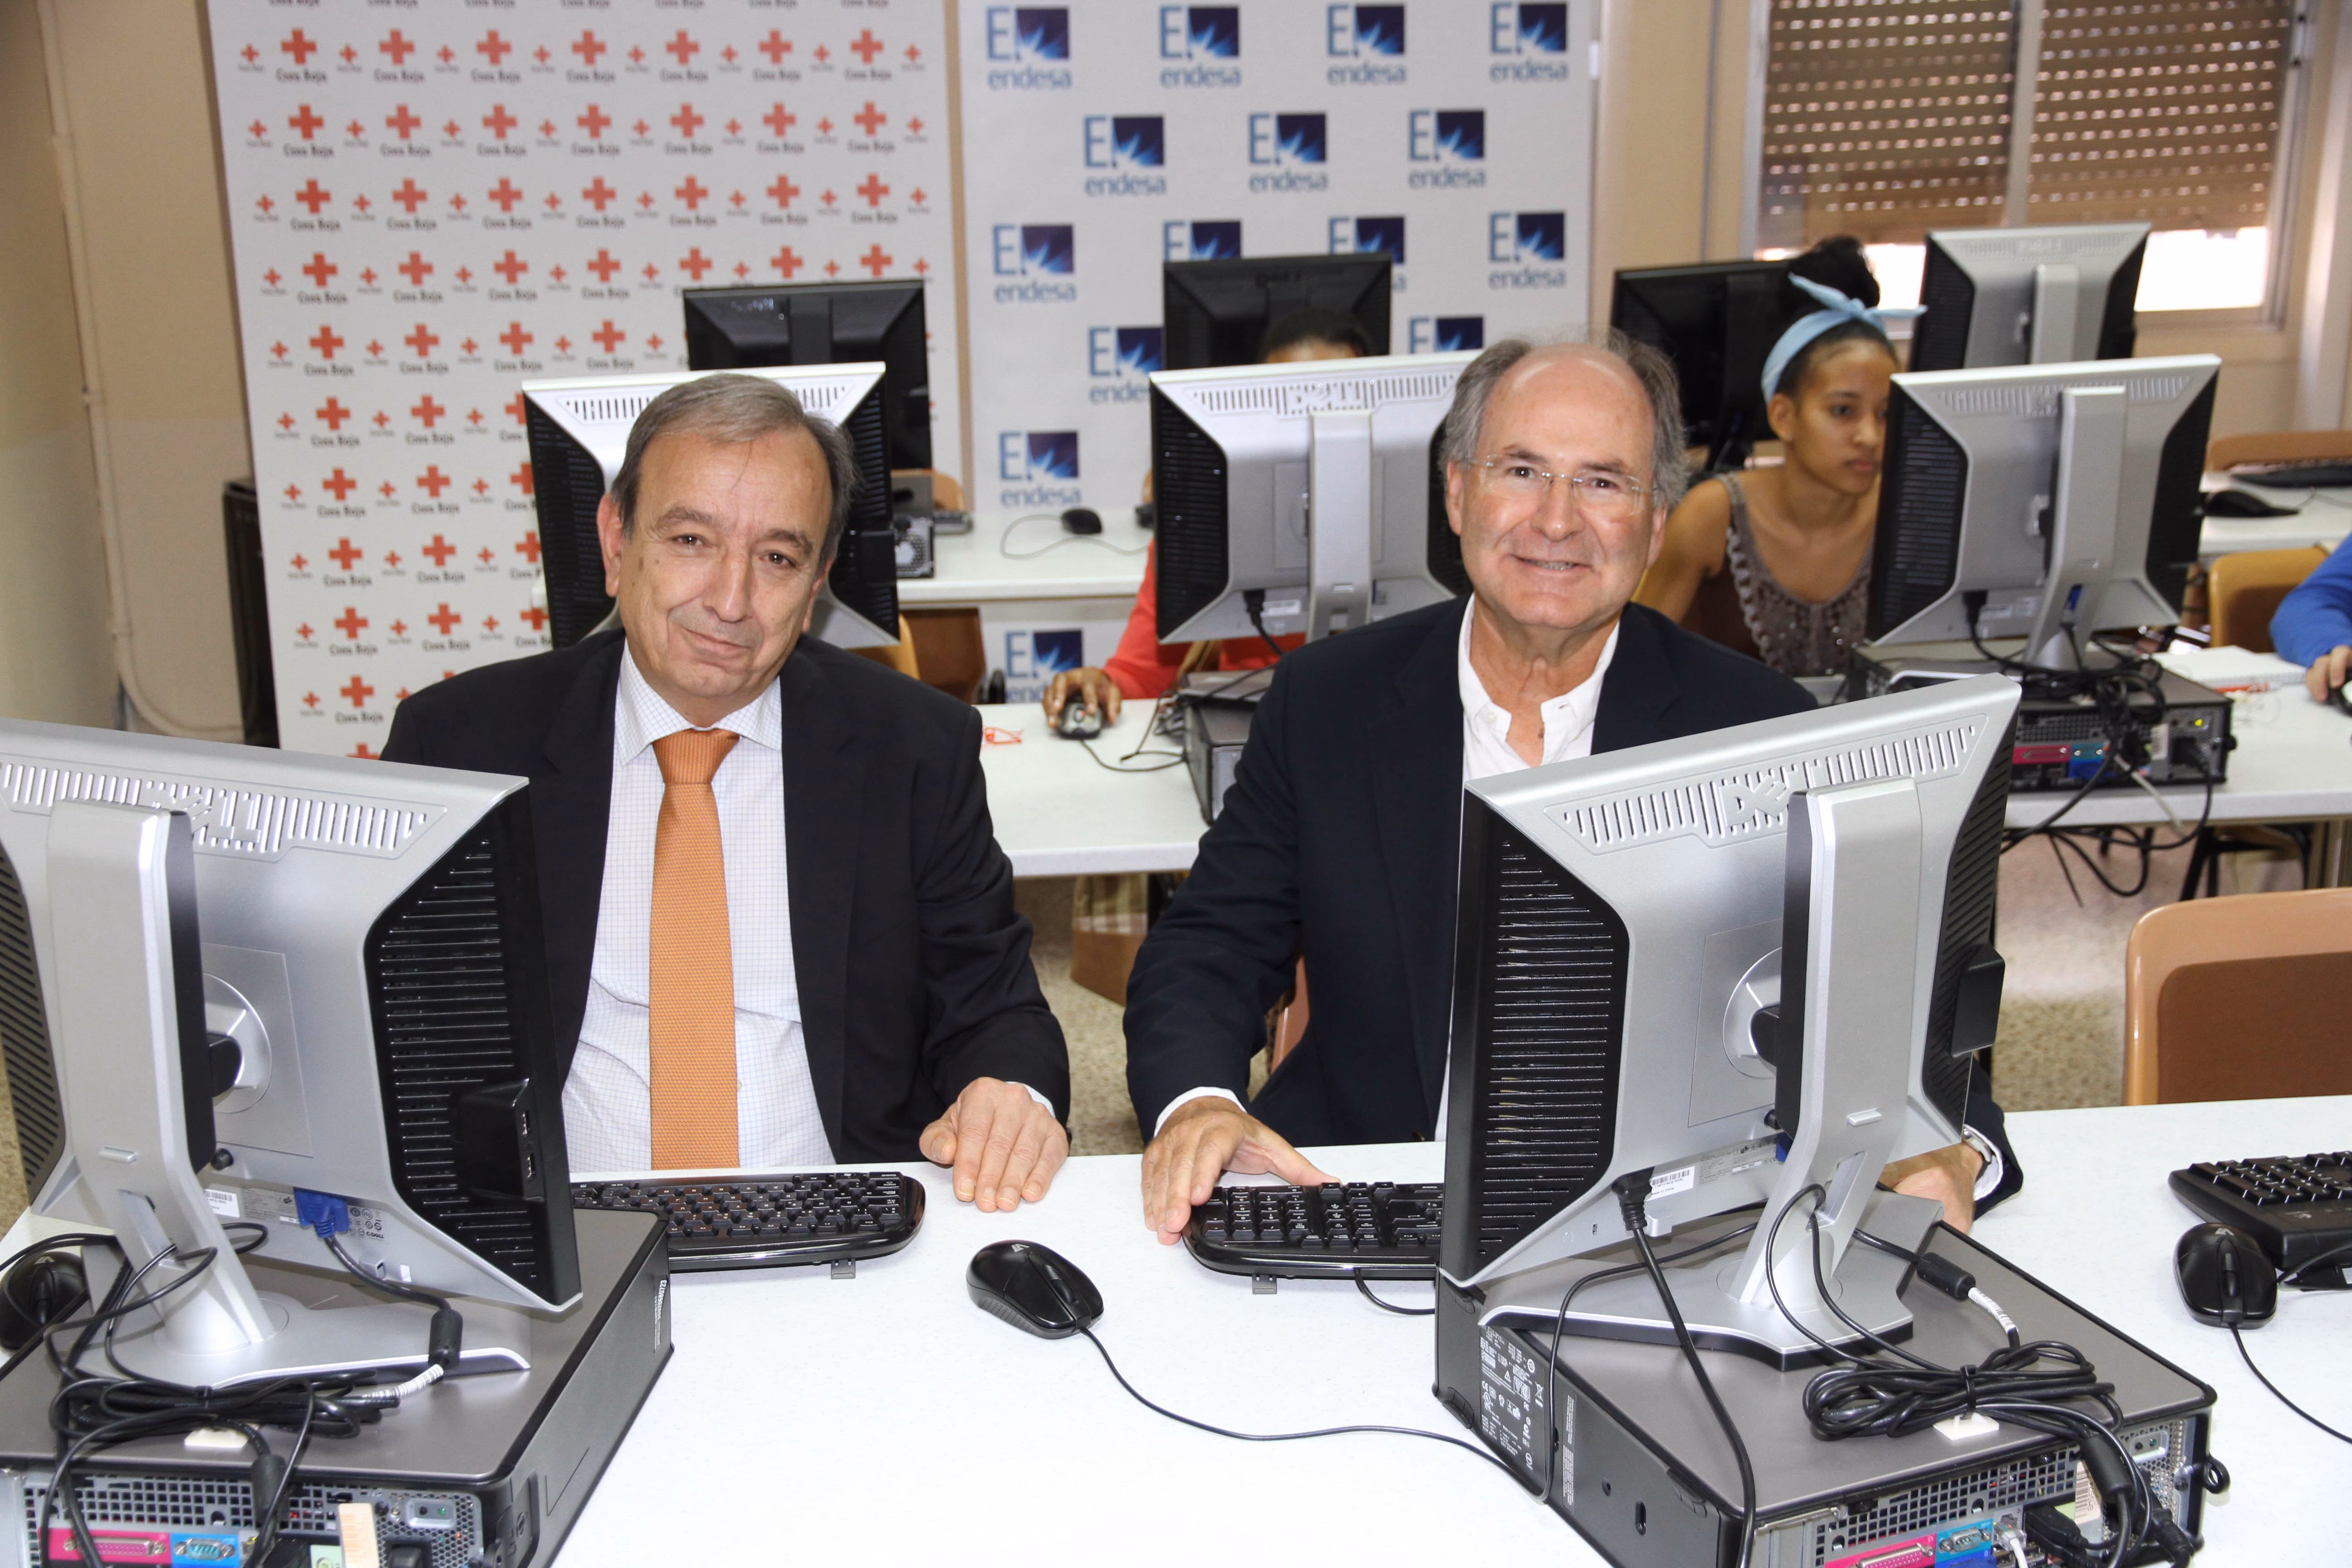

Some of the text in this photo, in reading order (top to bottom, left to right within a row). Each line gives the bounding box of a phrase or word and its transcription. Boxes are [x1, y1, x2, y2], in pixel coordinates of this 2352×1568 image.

[988, 63, 1072, 89] endesa
[1160, 62, 1240, 87] endesa
[1328, 60, 1406, 84] endesa
[1490, 59, 1567, 82] endesa
[1085, 171, 1166, 195] endesa
[1249, 169, 1328, 192] endesa
[1409, 166, 1485, 188] endesa
[1488, 265, 1566, 289] endesa
[995, 279, 1076, 303] endesa
[1000, 485, 1081, 508] endesa
